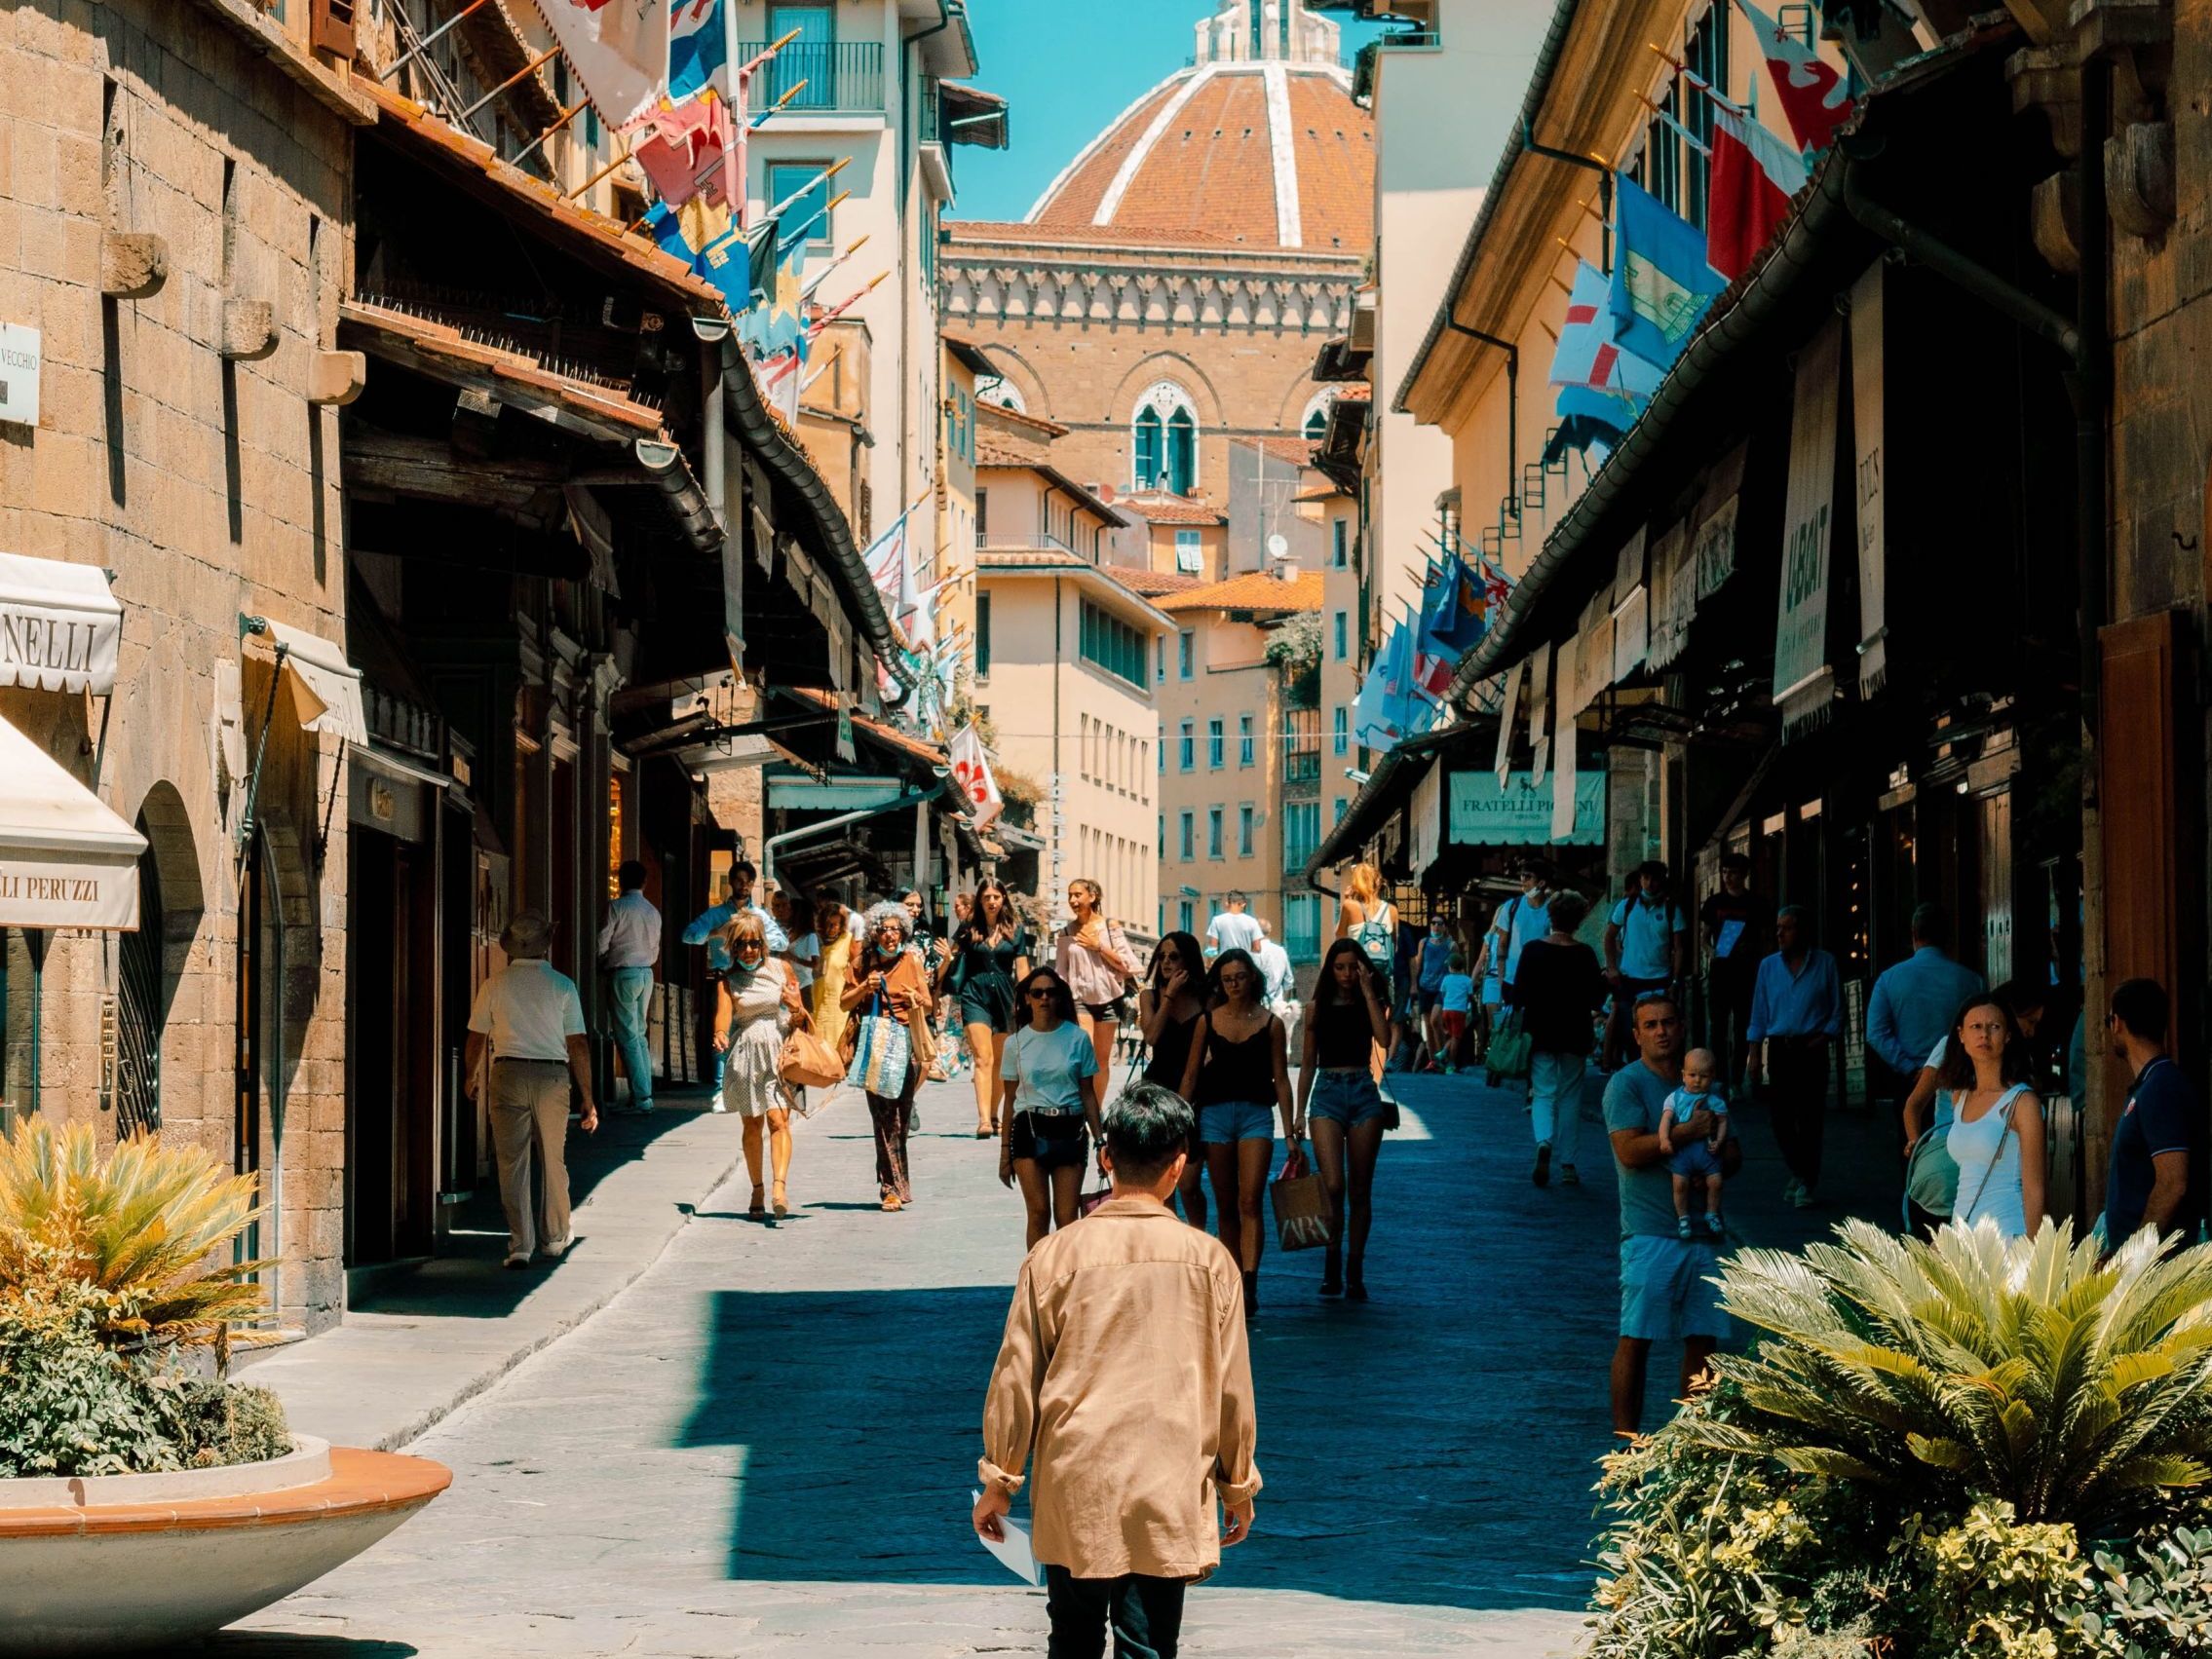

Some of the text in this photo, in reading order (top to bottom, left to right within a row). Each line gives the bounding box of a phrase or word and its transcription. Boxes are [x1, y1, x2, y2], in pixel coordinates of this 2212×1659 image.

[1, 348, 37, 371] VECCHIO
[3, 614, 96, 672] NELLI
[1463, 800, 1534, 811] FRATELLI
[27, 877, 99, 902] PERUZZI
